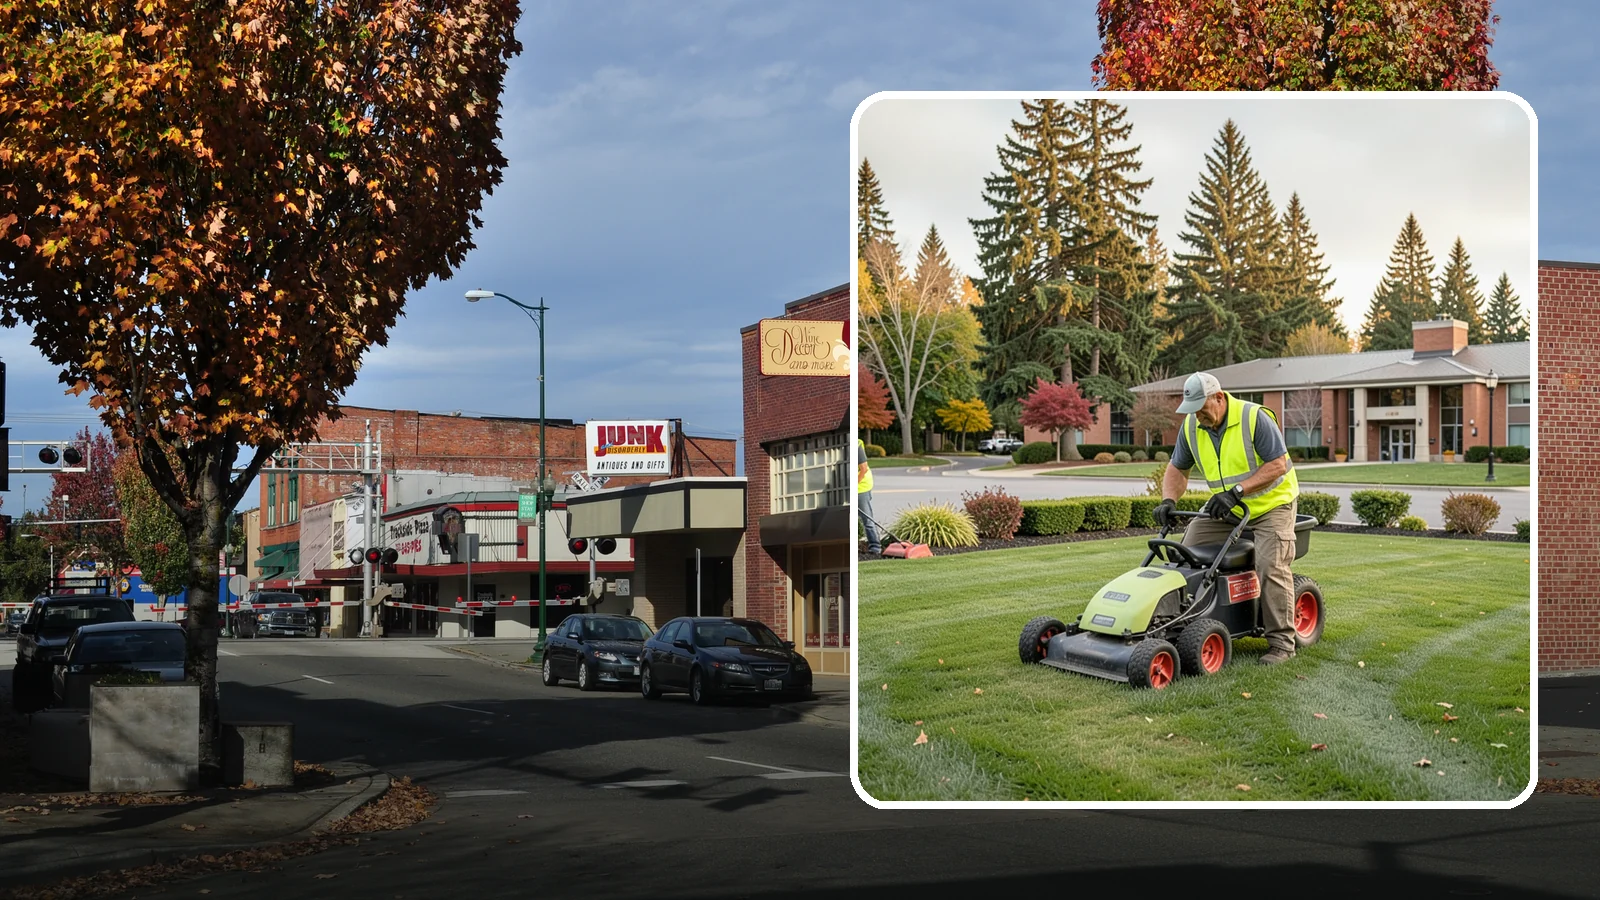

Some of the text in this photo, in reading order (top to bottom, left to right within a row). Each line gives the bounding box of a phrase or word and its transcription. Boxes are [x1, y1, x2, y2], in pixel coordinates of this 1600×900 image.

[596, 425, 664, 457] JUNK
[607, 446, 646, 454] DISORDERLY
[597, 460, 665, 470] ANTIQUES AND GIFTS
[390, 519, 429, 540] Trackside Pizza
